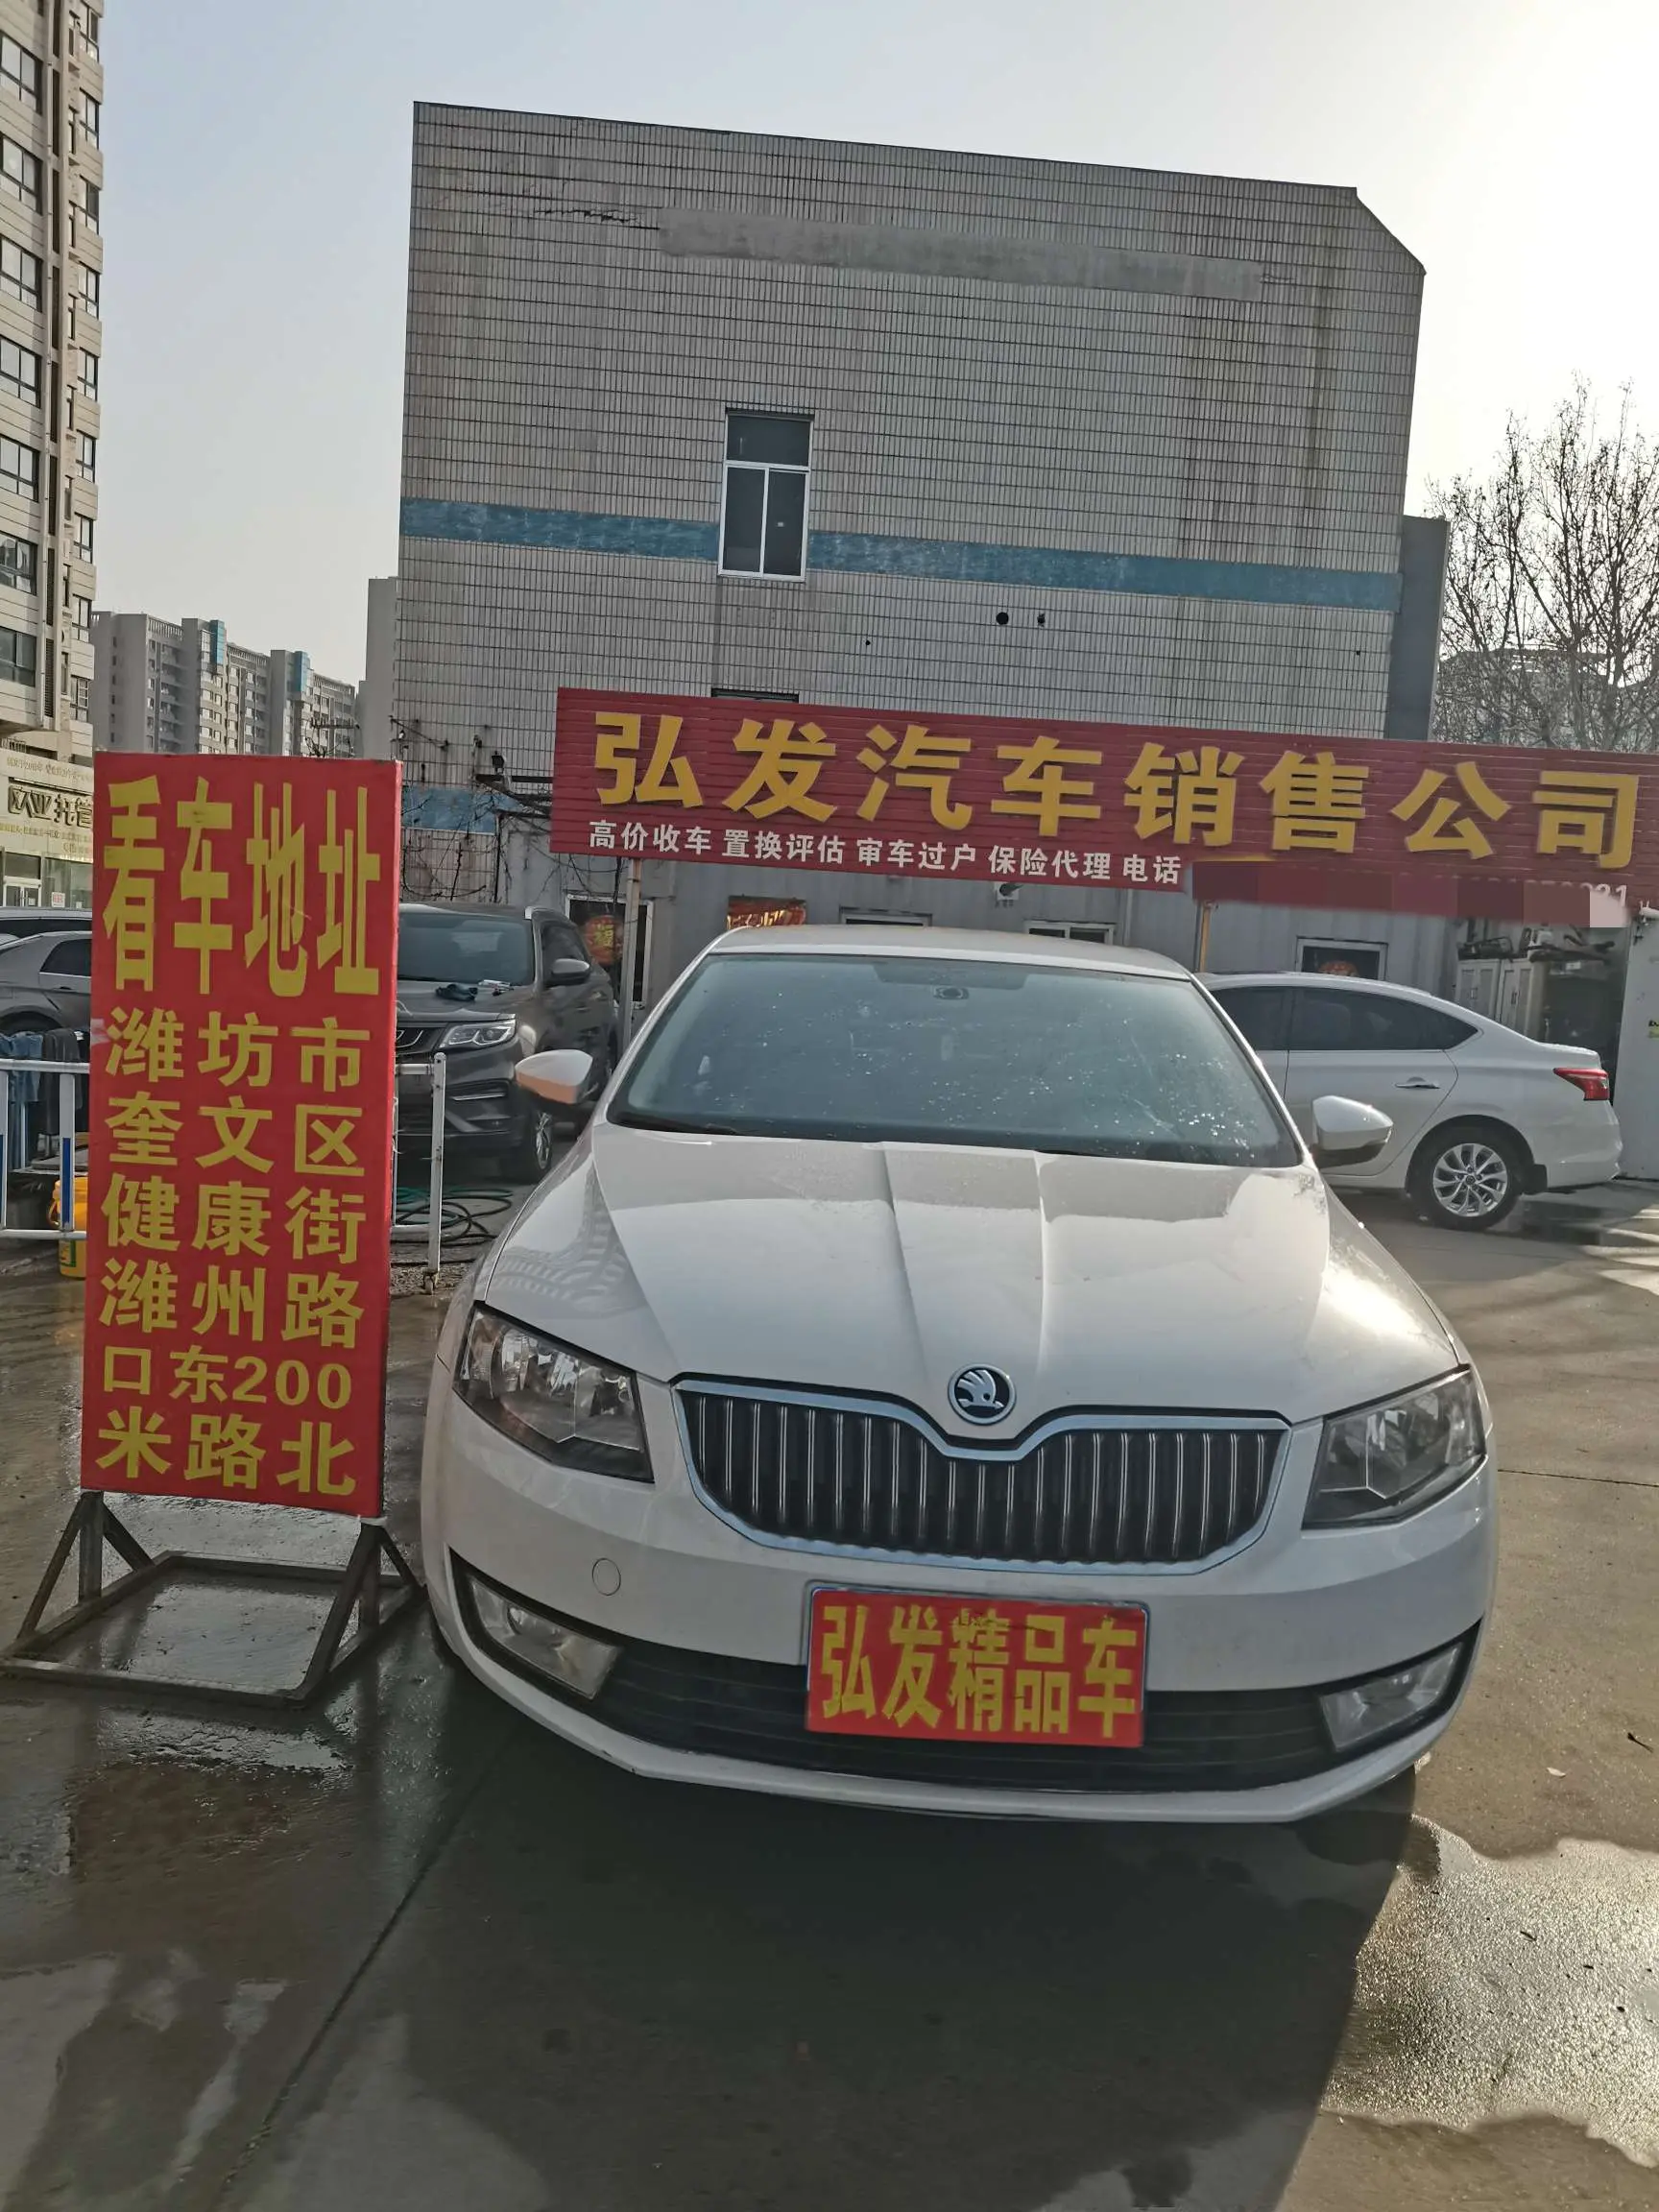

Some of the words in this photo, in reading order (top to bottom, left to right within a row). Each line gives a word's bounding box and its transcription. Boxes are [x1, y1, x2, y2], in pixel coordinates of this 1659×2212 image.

[595, 711, 1639, 869] 弘发汽车销售公司
[103, 775, 381, 997] 看车地址
[589, 819, 711, 854] 高价收车
[722, 830, 846, 864] 置换评估
[856, 837, 976, 871] 审车过户
[989, 845, 1111, 880] 保险代理
[1122, 854, 1182, 884] 电话
[105, 1006, 371, 1093] 潍坊市
[105, 1091, 365, 1176] 奎文区
[101, 1172, 367, 1264] 健康街
[99, 1258, 364, 1349] 潍州路
[103, 1345, 352, 1409] 口东200
[95, 1407, 357, 1497] 米路北
[821, 1604, 1138, 1739] 弘发精品车
